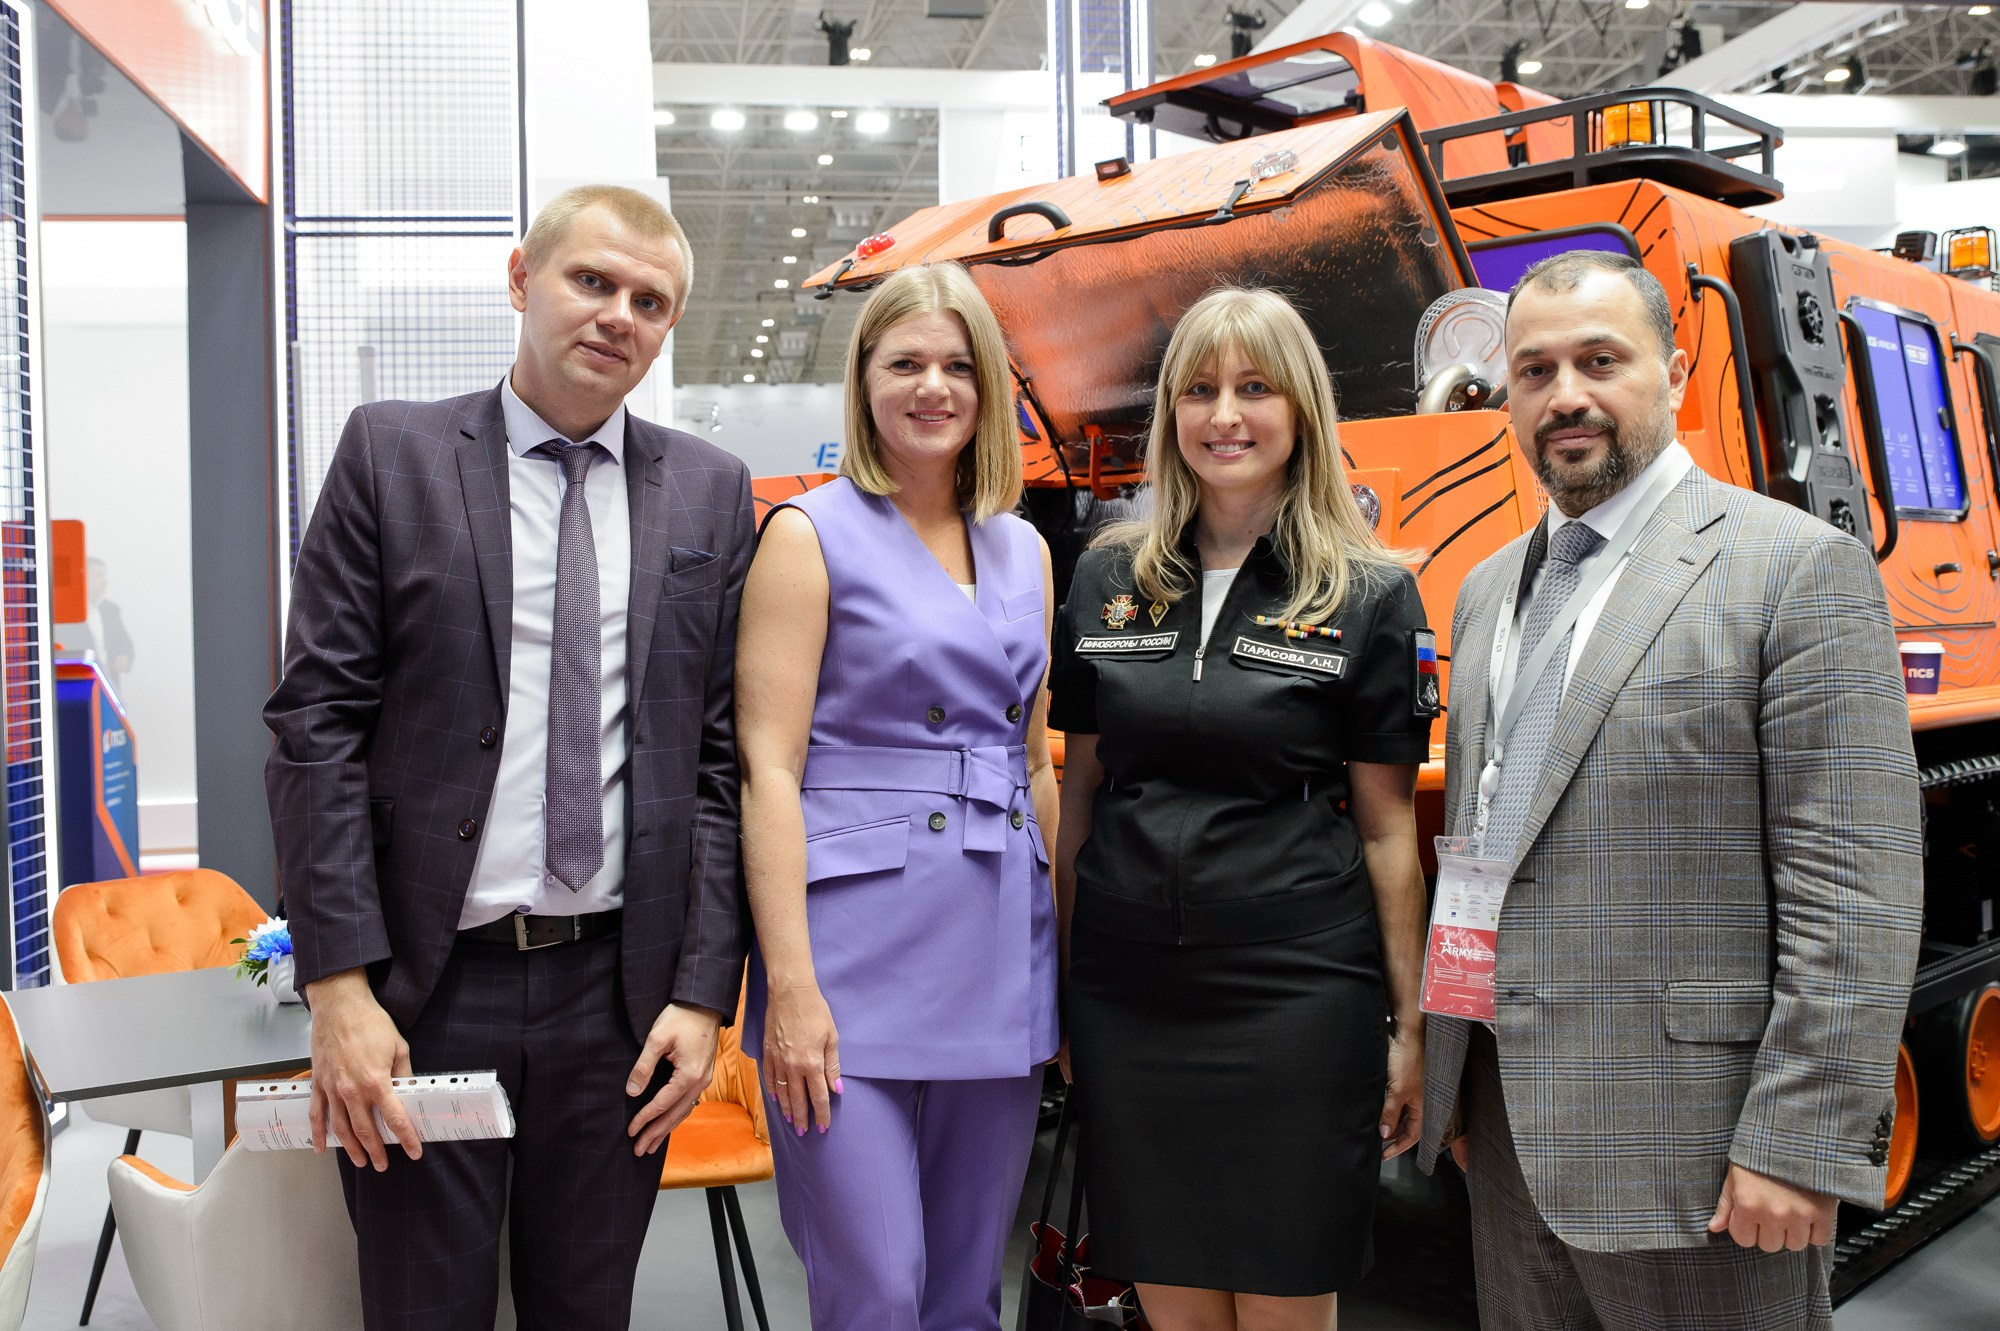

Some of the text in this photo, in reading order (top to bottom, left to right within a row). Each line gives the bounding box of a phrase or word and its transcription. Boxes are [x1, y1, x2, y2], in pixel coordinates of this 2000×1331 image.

[1082, 636, 1172, 649] МИНОБОРОНЫ РОССИИ
[1242, 643, 1335, 669] ТАРАСОВА Л.Н.
